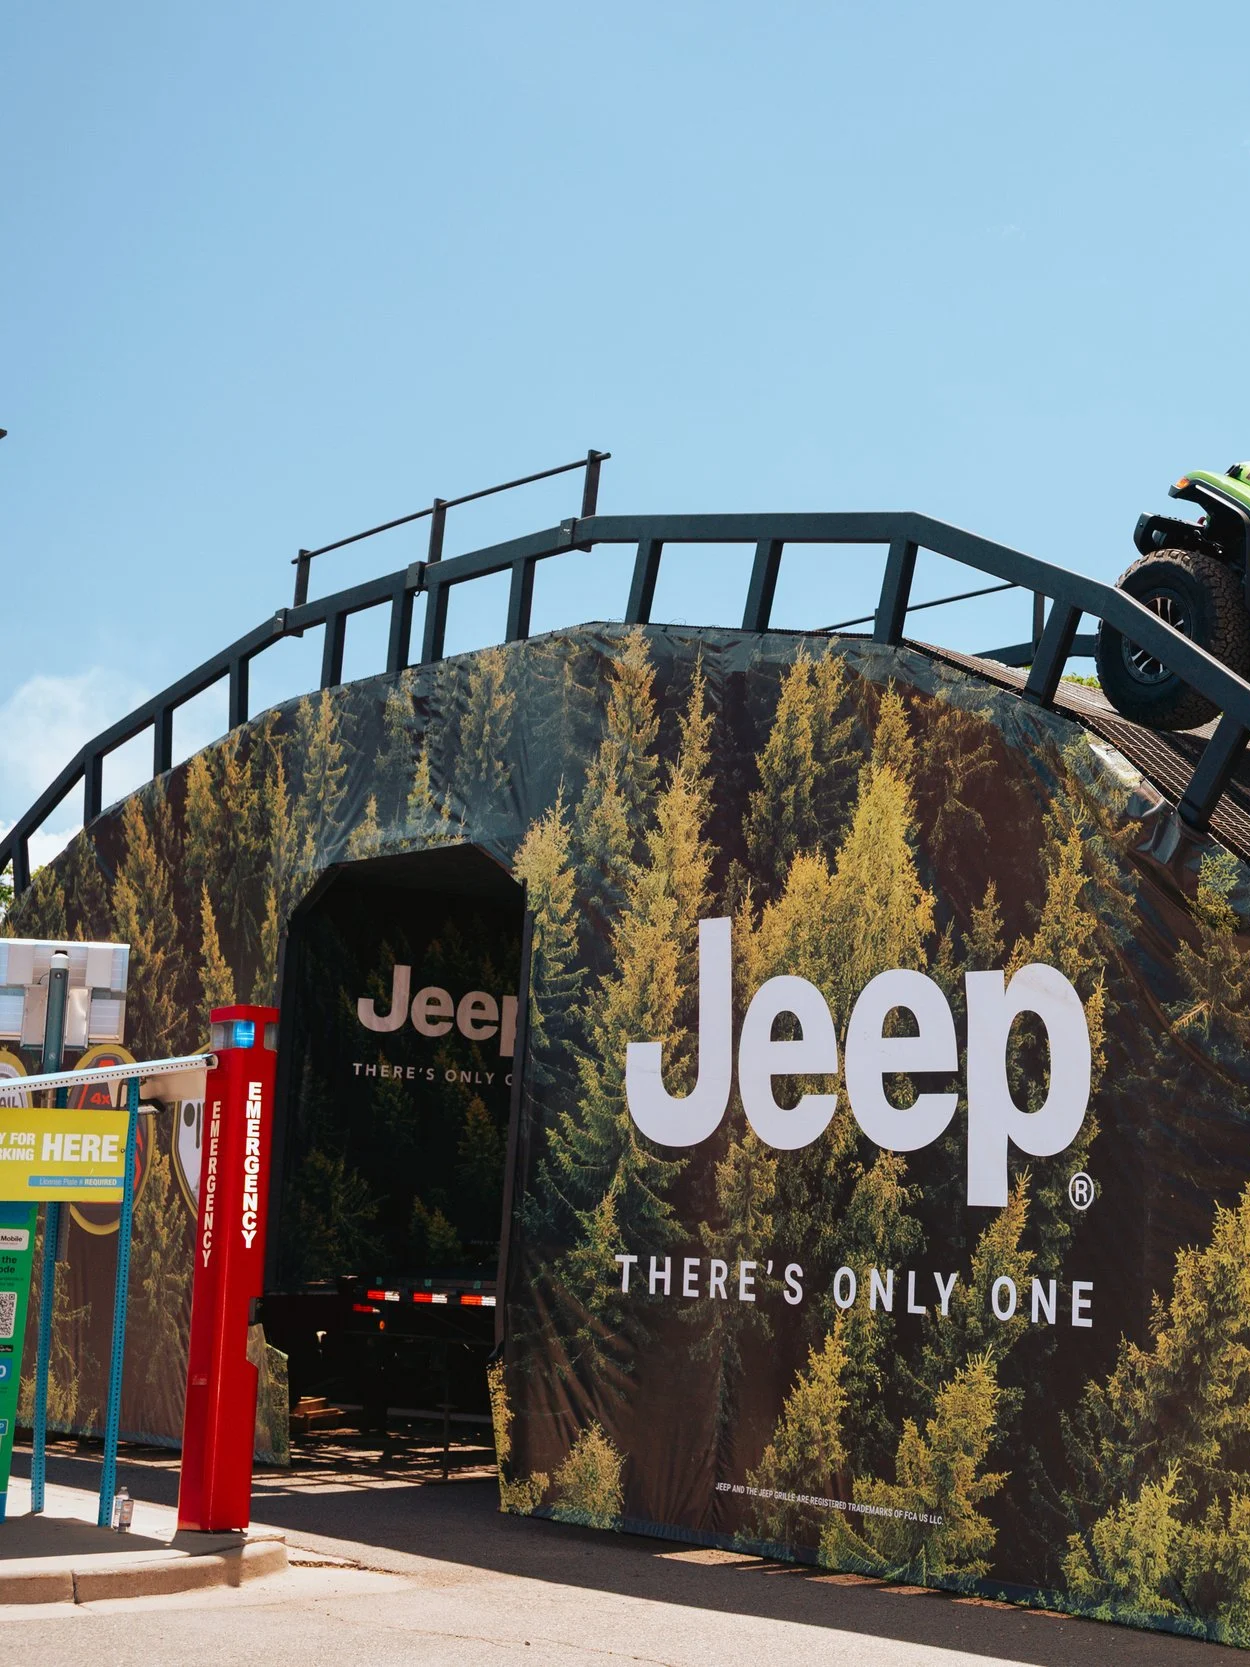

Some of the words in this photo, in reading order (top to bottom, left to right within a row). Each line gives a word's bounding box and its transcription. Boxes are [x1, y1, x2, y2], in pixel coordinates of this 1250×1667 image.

[353, 1063, 435, 1081] THERE'S
[445, 1069, 495, 1084] ONLY
[626, 916, 1092, 1207] Jeep
[9, 1132, 36, 1146] FOR
[41, 1133, 120, 1162] HERE
[241, 1081, 263, 1249] EMERGENCY
[202, 1101, 221, 1268] EMERGENCY
[614, 1253, 804, 1306] THERE'S
[833, 1266, 959, 1317] ONLY
[991, 1275, 1095, 1328] ONE
[715, 1482, 732, 1492] JEEP
[731, 1484, 745, 1494] AND
[746, 1486, 758, 1496] THE
[758, 1488, 774, 1498] JEEP
[774, 1491, 796, 1501] GRILLE
[796, 1494, 810, 1504] ARE
[810, 1496, 847, 1510] REGISTERED
[848, 1502, 893, 1518] TRADEMARKS
[893, 1509, 903, 1519] OF
[904, 1511, 918, 1521] FCA
[919, 1514, 928, 1523] US
[929, 1515, 944, 1526] LLC.
